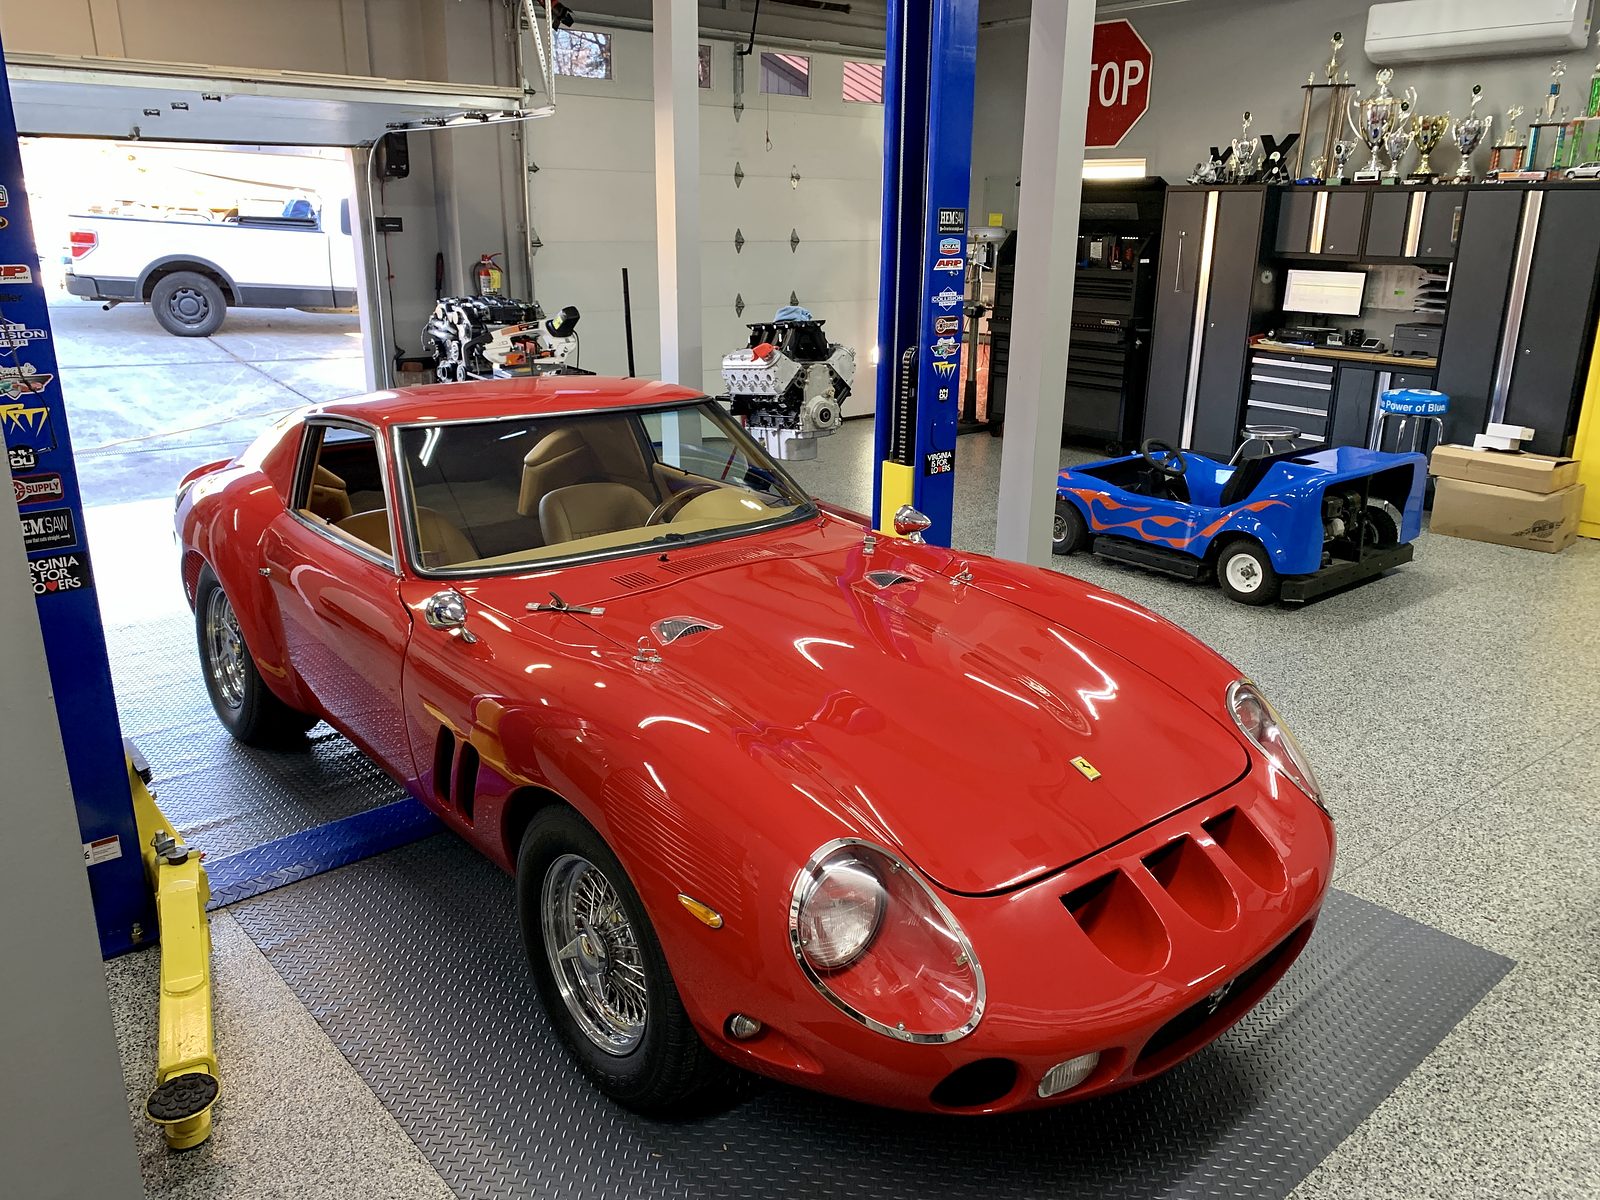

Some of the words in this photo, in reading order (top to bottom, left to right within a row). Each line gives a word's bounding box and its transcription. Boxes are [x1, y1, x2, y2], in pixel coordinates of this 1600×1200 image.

[937, 259, 962, 267] ARP
[1386, 400, 1413, 412] Power
[1415, 403, 1426, 412] of
[1428, 403, 1446, 412] Blue
[927, 452, 952, 461] VIRGINIA
[937, 459, 948, 467] FOR
[26, 482, 59, 494] SUPPLY
[40, 568, 72, 582] FOR
